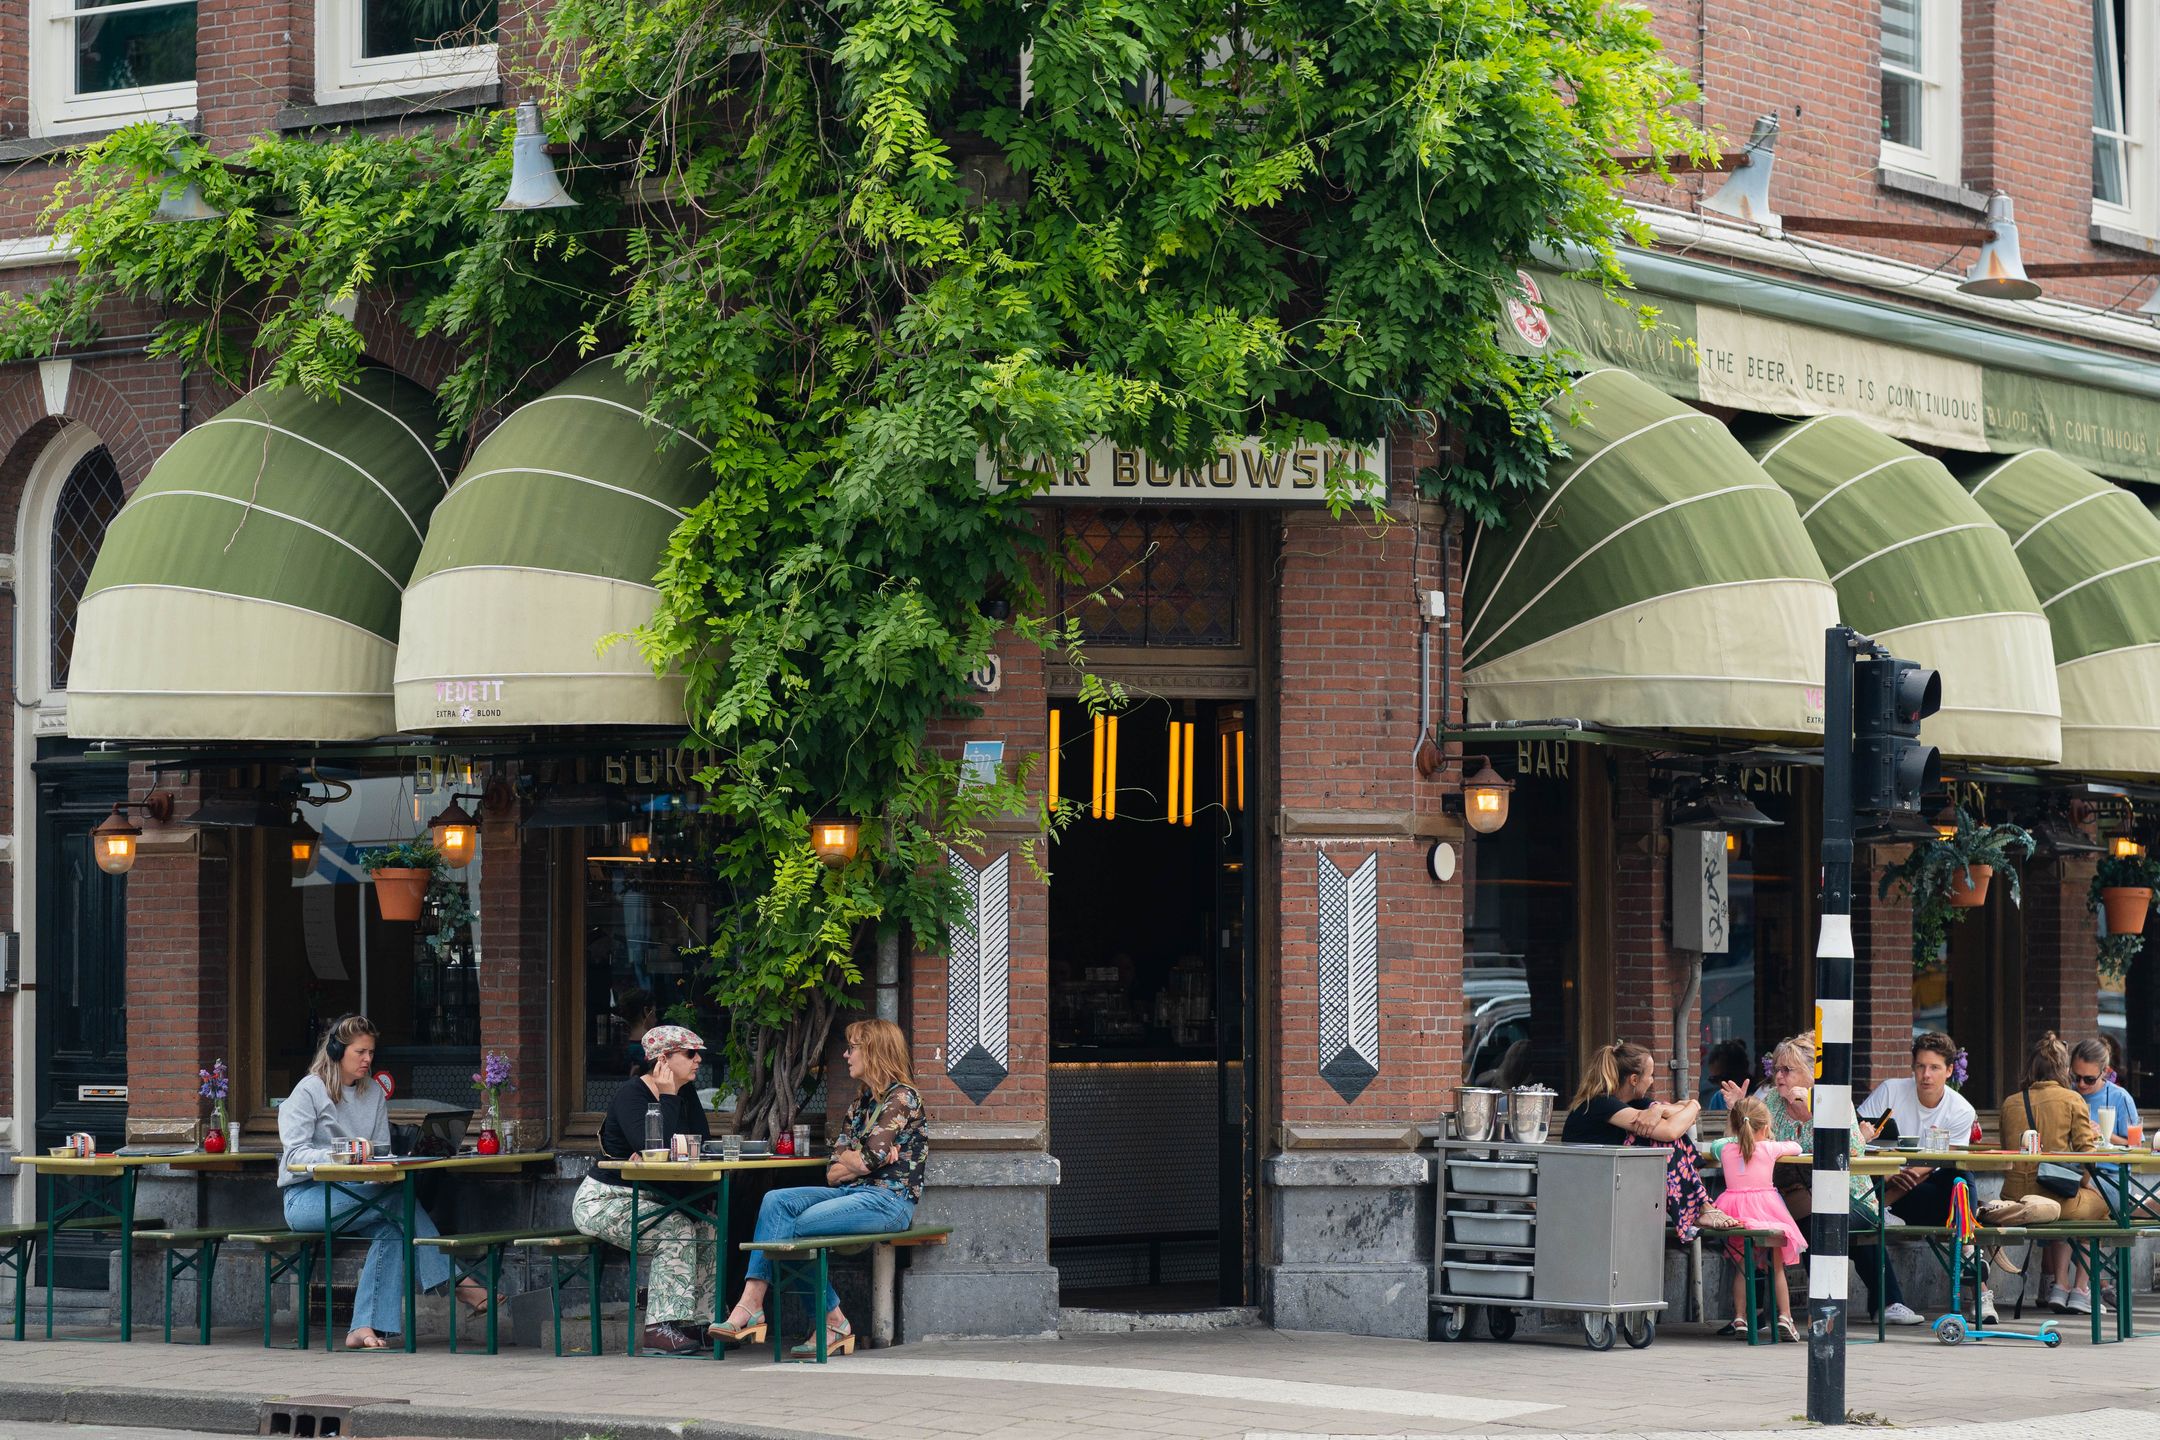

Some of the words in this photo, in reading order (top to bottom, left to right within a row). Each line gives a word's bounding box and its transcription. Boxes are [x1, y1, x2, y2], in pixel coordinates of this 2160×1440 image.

[1706, 349, 1734, 374] THE
[1748, 356, 1795, 385] BEER.
[1858, 378, 1875, 402] IS
[1888, 384, 1978, 423] CONTINUOUS
[2049, 412, 2057, 438] A
[2065, 420, 2147, 454] CONTINUOUS
[434, 680, 504, 702] VEDETT
[436, 710, 457, 718] EXTRA
[477, 709, 501, 717] BLOND
[1518, 740, 1569, 780] BAR
